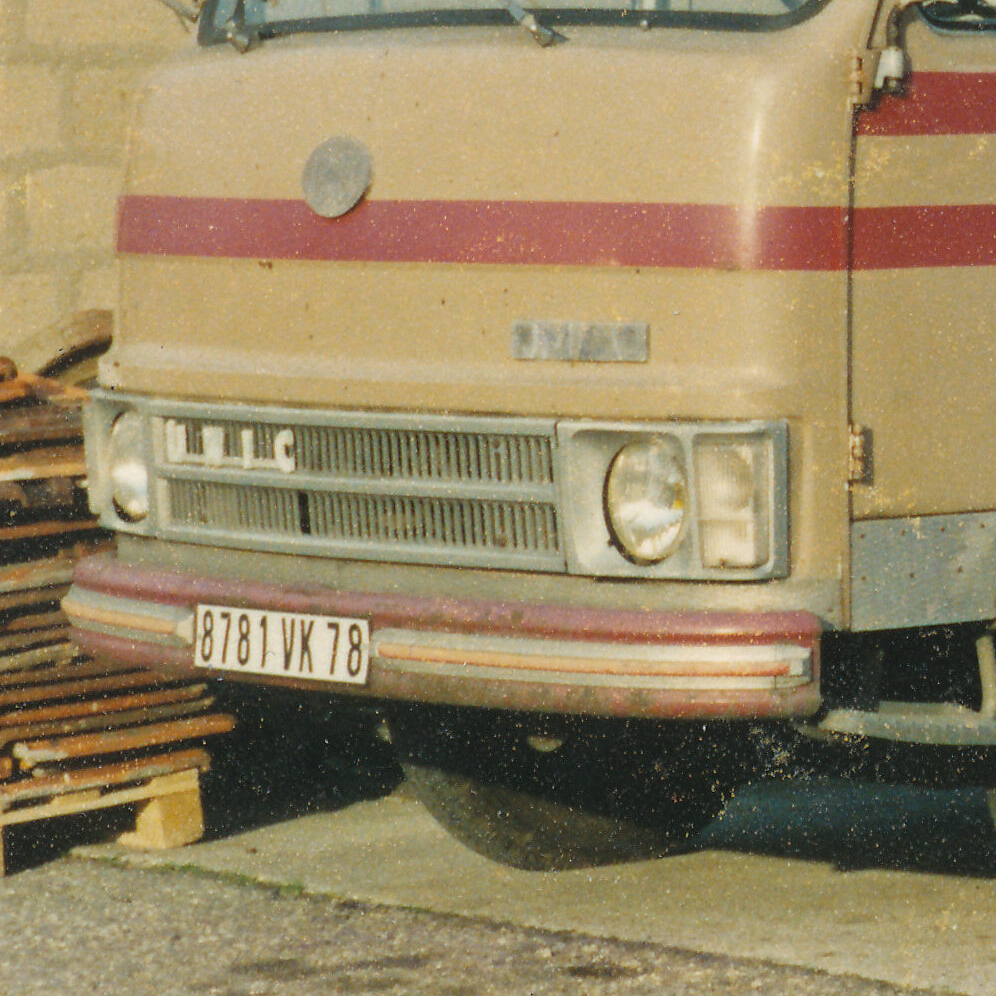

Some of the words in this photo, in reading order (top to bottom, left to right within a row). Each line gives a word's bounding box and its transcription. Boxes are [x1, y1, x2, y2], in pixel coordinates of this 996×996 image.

[201, 609, 268, 668] 8781
[281, 616, 315, 673] VK
[327, 622, 363, 677] 78
